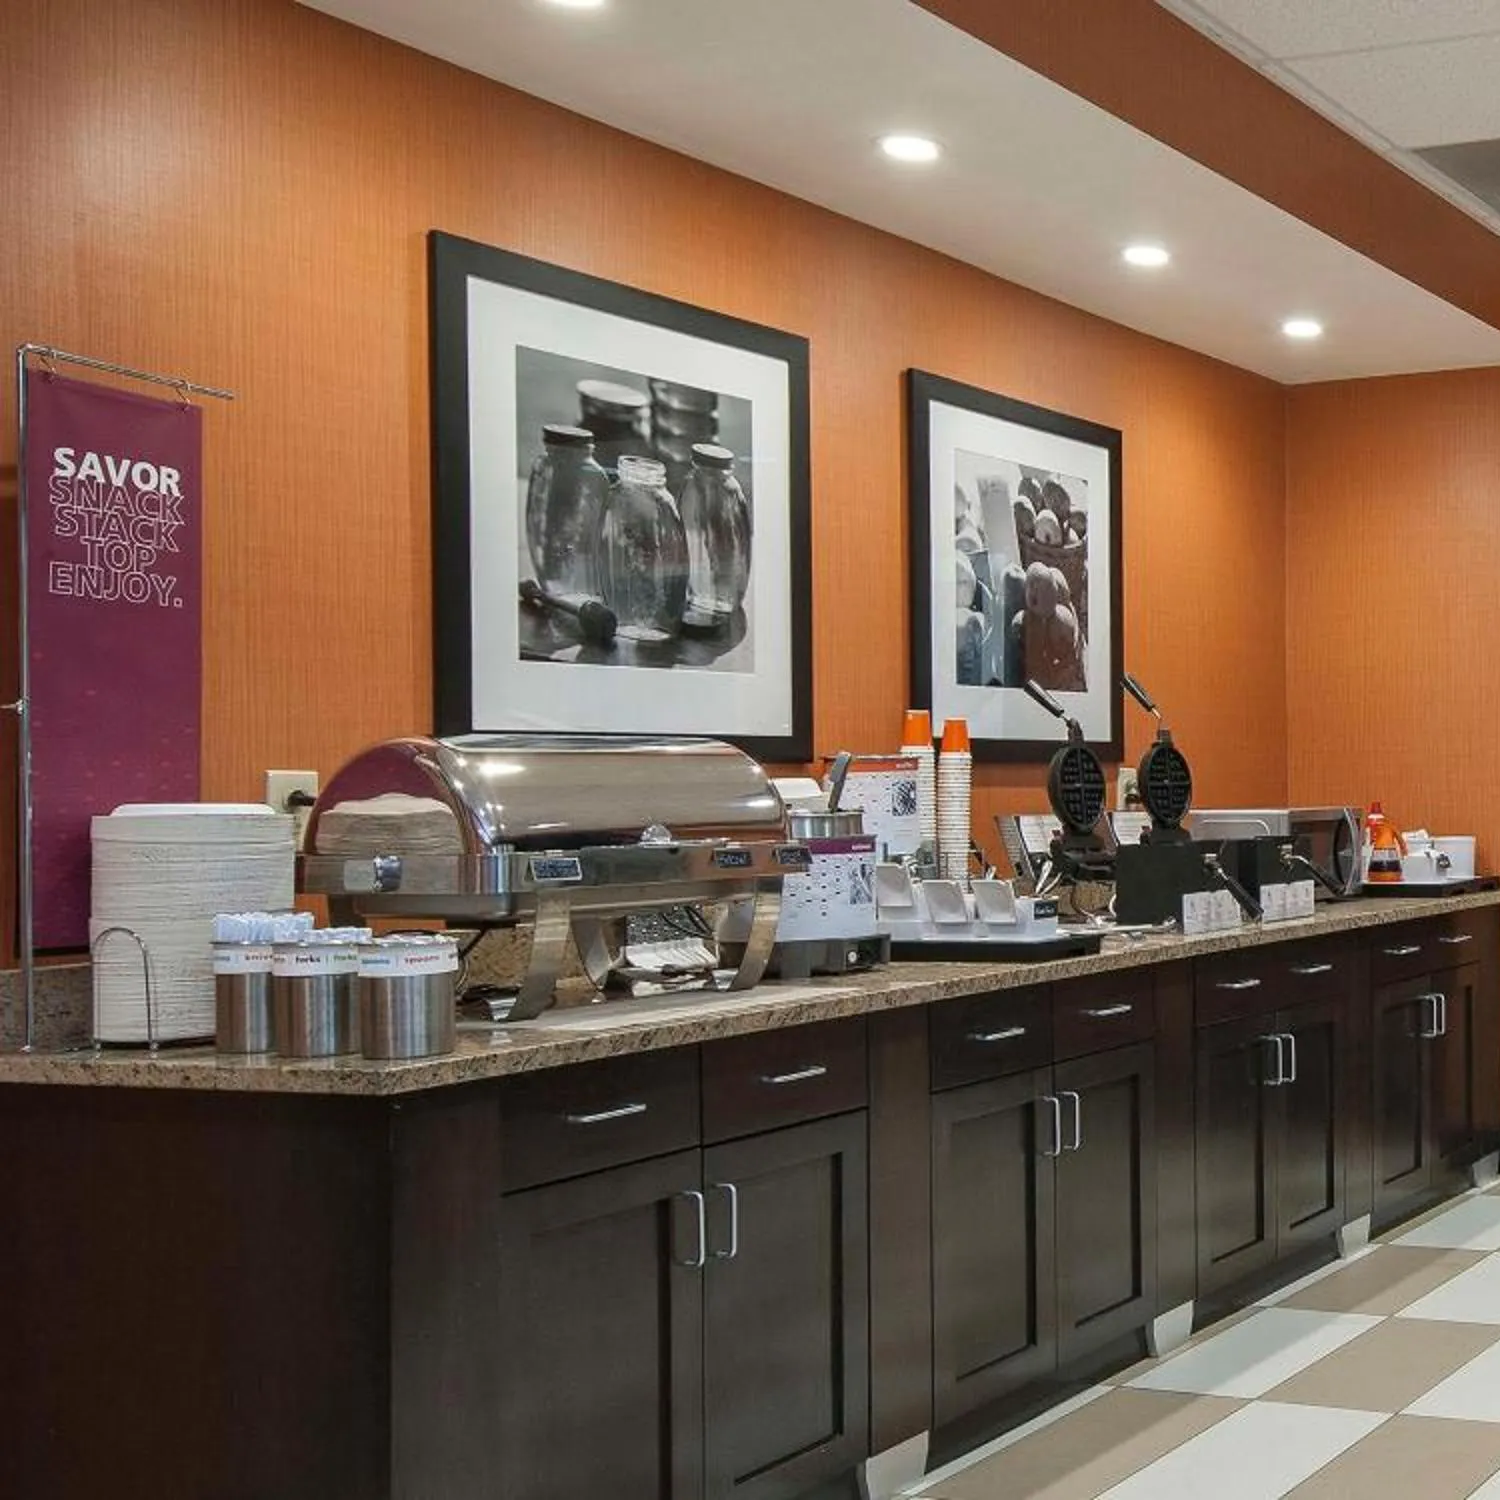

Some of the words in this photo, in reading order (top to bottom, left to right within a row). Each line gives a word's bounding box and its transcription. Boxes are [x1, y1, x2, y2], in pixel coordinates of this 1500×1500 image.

[53, 447, 181, 497] SAVOR
[49, 473, 185, 525] SNACK
[55, 504, 179, 552] STACK
[80, 538, 156, 573] TOP
[49, 561, 183, 608] ENJOY.
